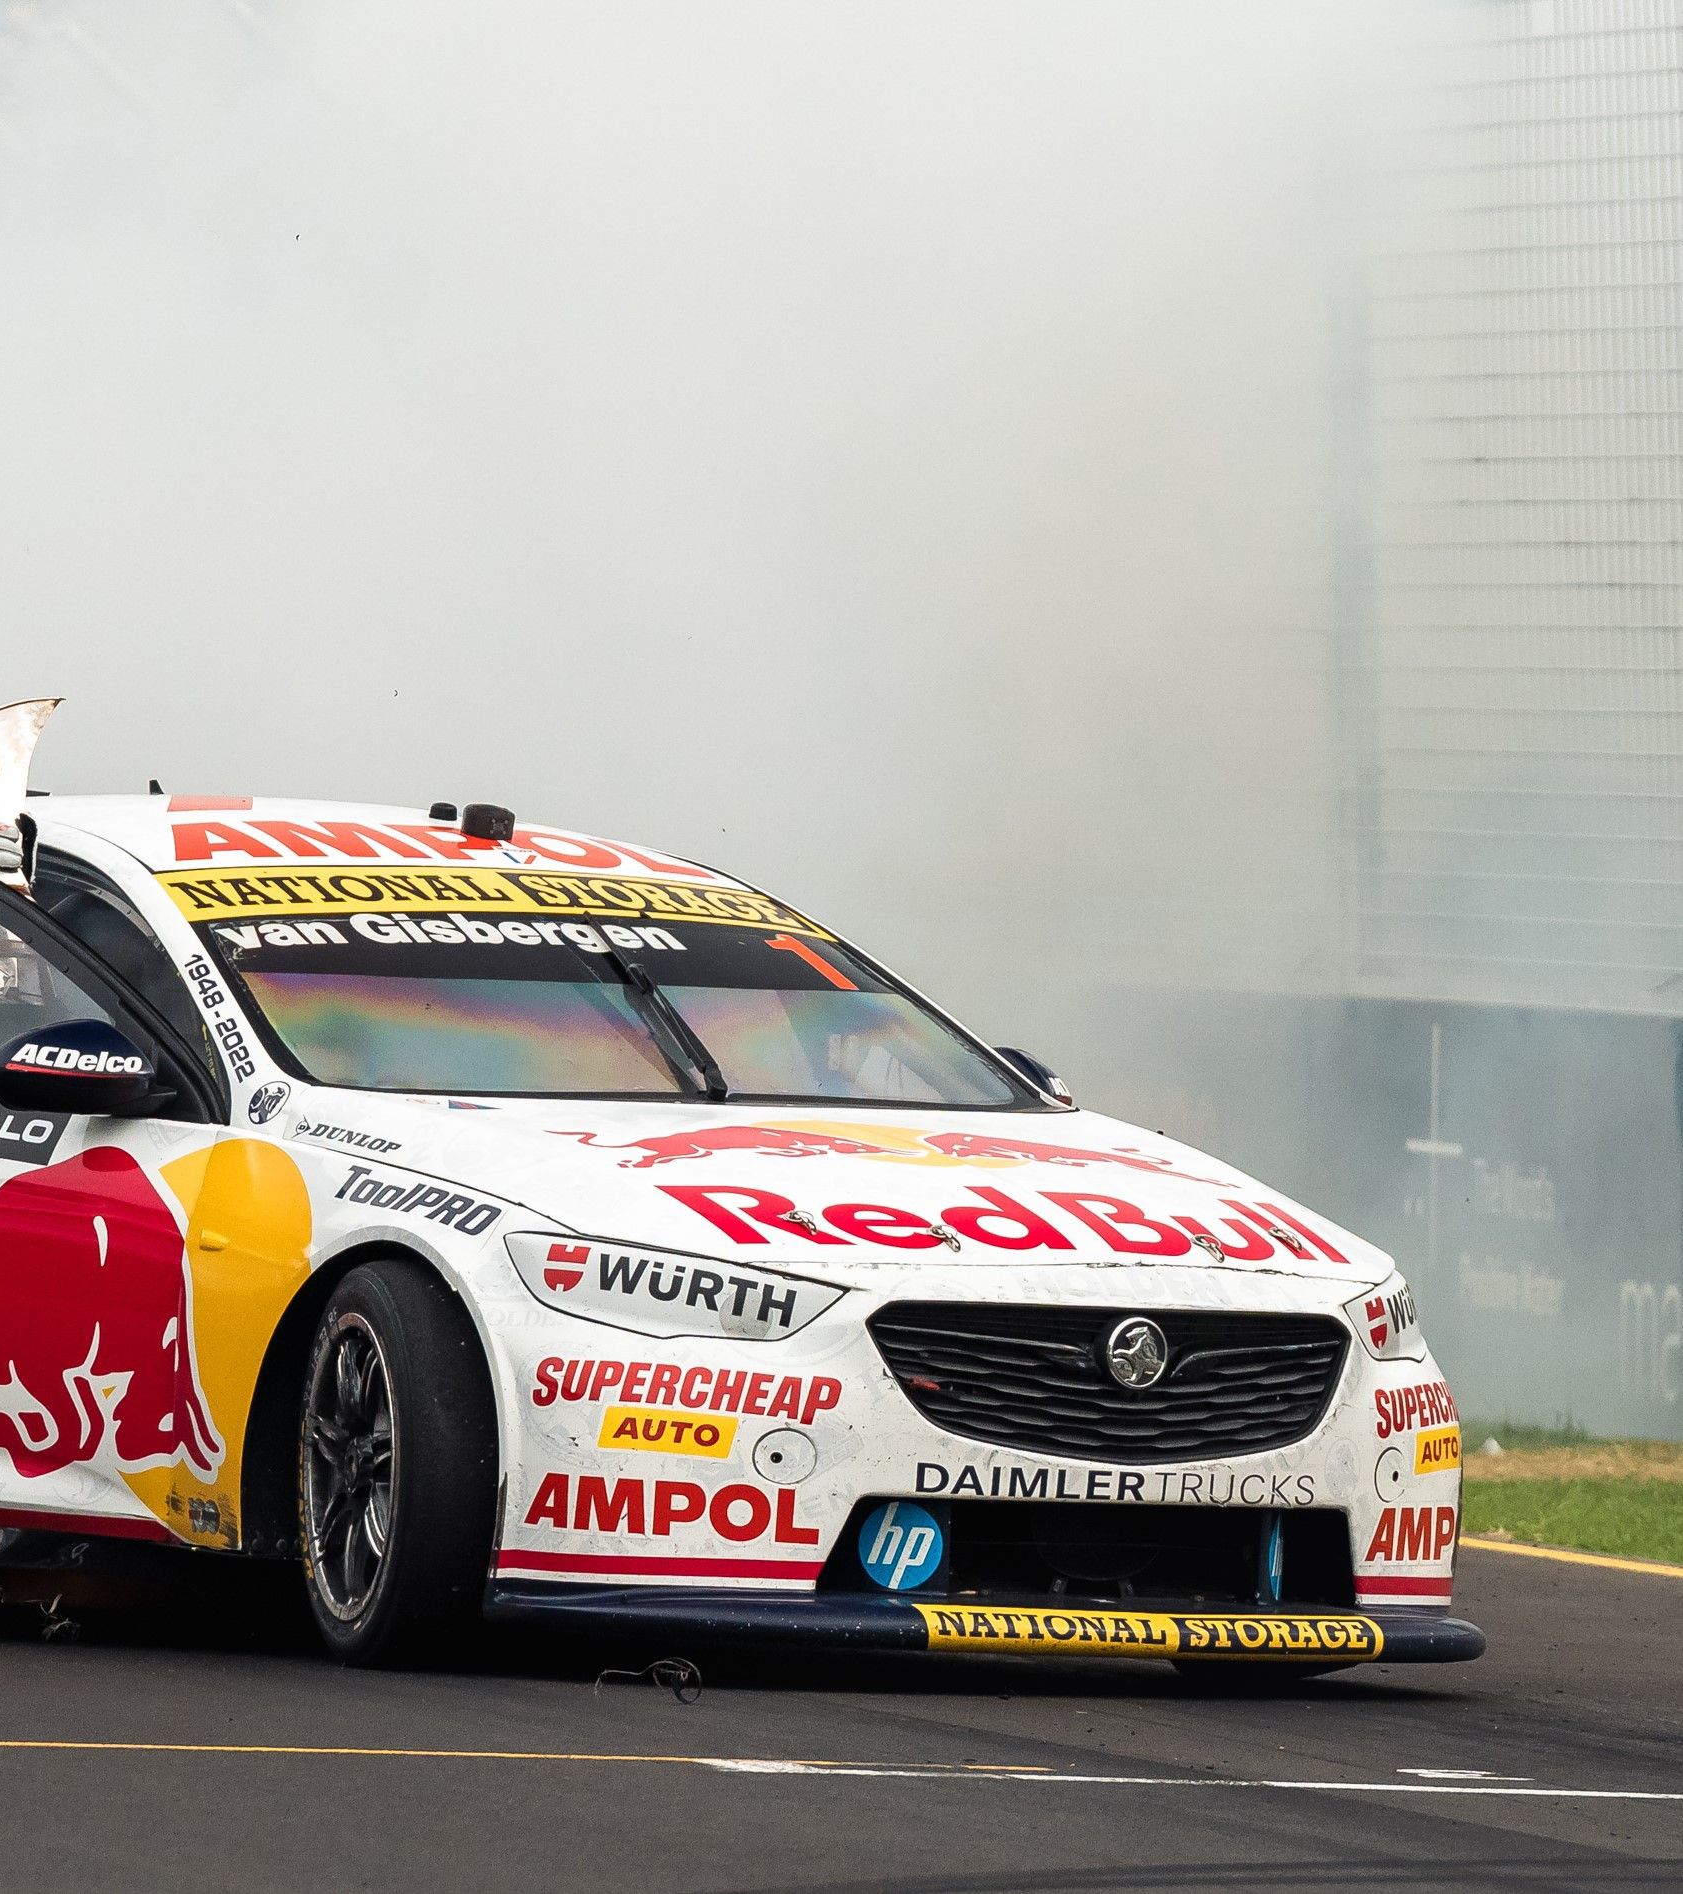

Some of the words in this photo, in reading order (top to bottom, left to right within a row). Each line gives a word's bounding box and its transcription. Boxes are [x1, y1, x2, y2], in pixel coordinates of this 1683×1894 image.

[170, 874, 514, 909] NATIONAL
[519, 875, 801, 928] STORAGE
[215, 917, 348, 951] van
[347, 913, 687, 953] Gisbergen
[765, 934, 860, 990] 1
[11, 1043, 143, 1073] ACDelco
[309, 1122, 402, 1153] DUNLOP
[334, 1165, 502, 1236] ToolPRO
[655, 1185, 1077, 1250] Red
[1035, 1190, 1350, 1264] Bull
[598, 1253, 798, 1328] WÜRTH
[532, 1356, 843, 1426] SUPERCHEAP
[613, 1417, 720, 1447] AUTO
[1420, 1435, 1460, 1464] AUTO
[524, 1473, 820, 1545] AMPOL
[916, 1462, 1146, 1502] DAIMLER
[1155, 1471, 1316, 1506] TRUCKS
[866, 1502, 936, 1589] hp
[1366, 1506, 1457, 1562] AMP
[936, 1608, 1167, 1646] NATIONAL
[1188, 1617, 1370, 1650] STORAGE
